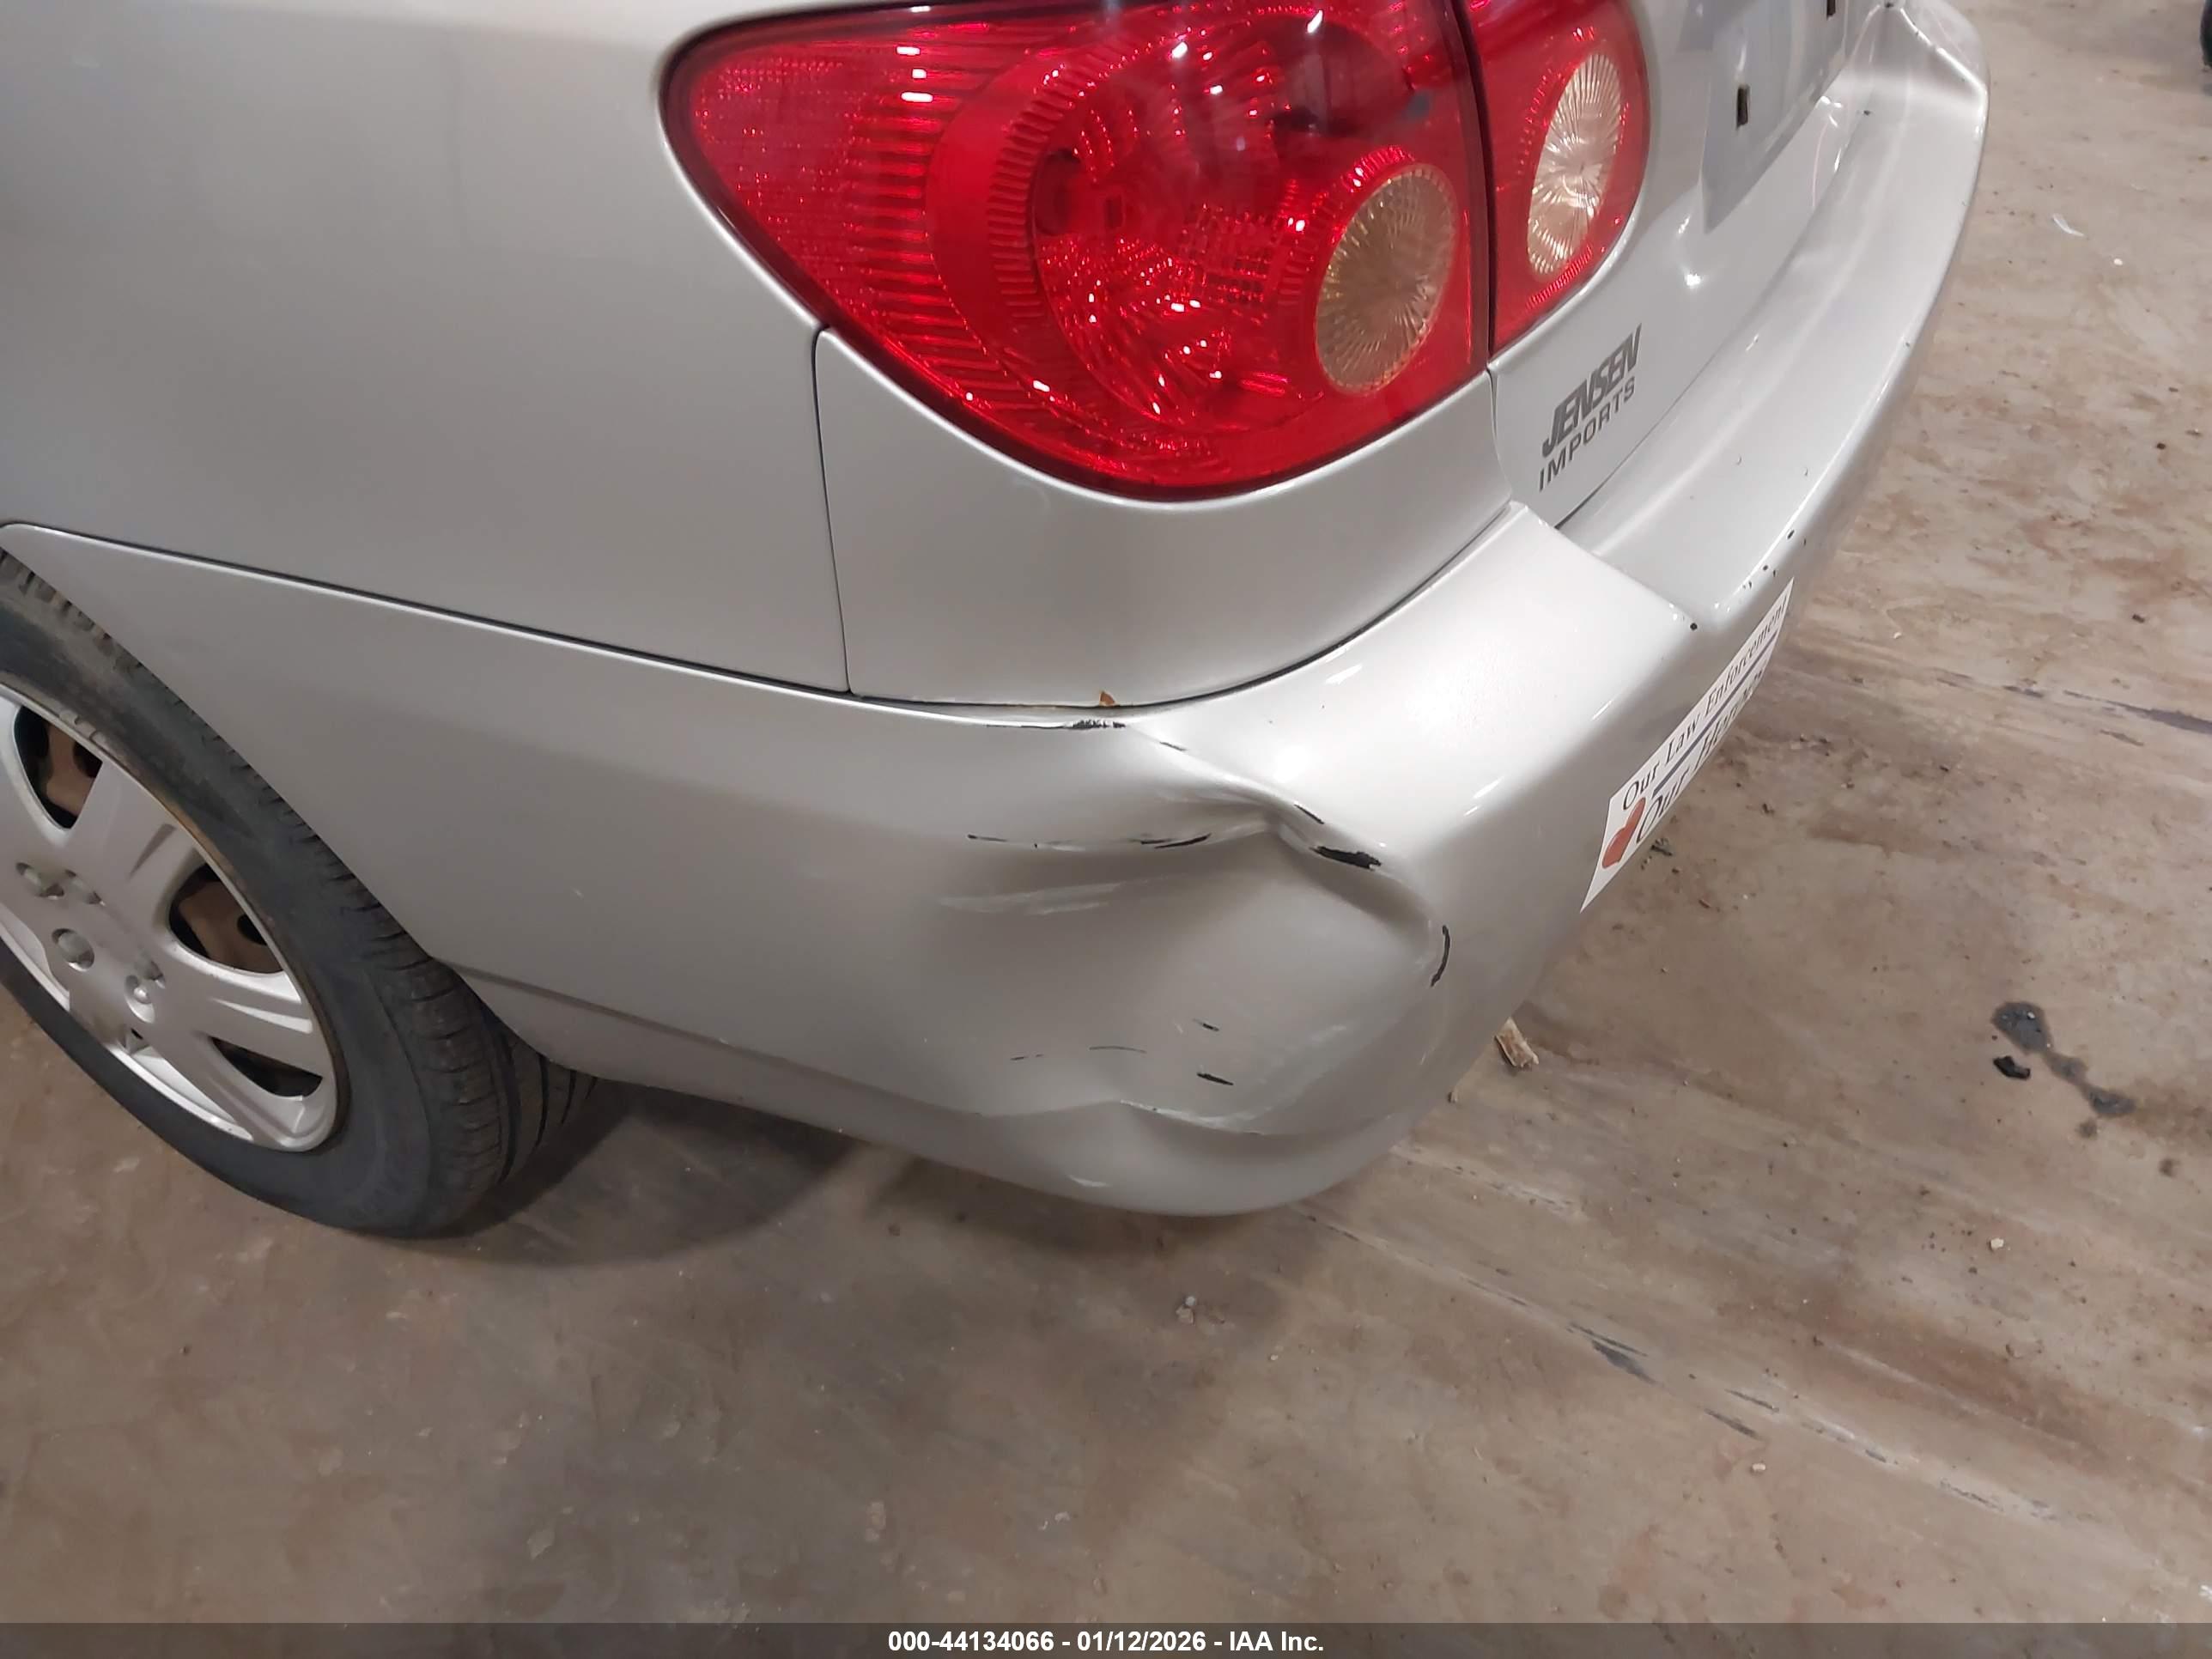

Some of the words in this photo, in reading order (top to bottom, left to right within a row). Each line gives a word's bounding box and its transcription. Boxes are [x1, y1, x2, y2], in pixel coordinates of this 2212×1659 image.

[1539, 376, 1635, 492] IMPORTS
[1542, 322, 1642, 458] JENSEN
[1623, 761, 1660, 811] Our
[1665, 712, 1700, 766] Law
[1705, 594, 1787, 716] Enforcement
[1636, 765, 1690, 844] Our
